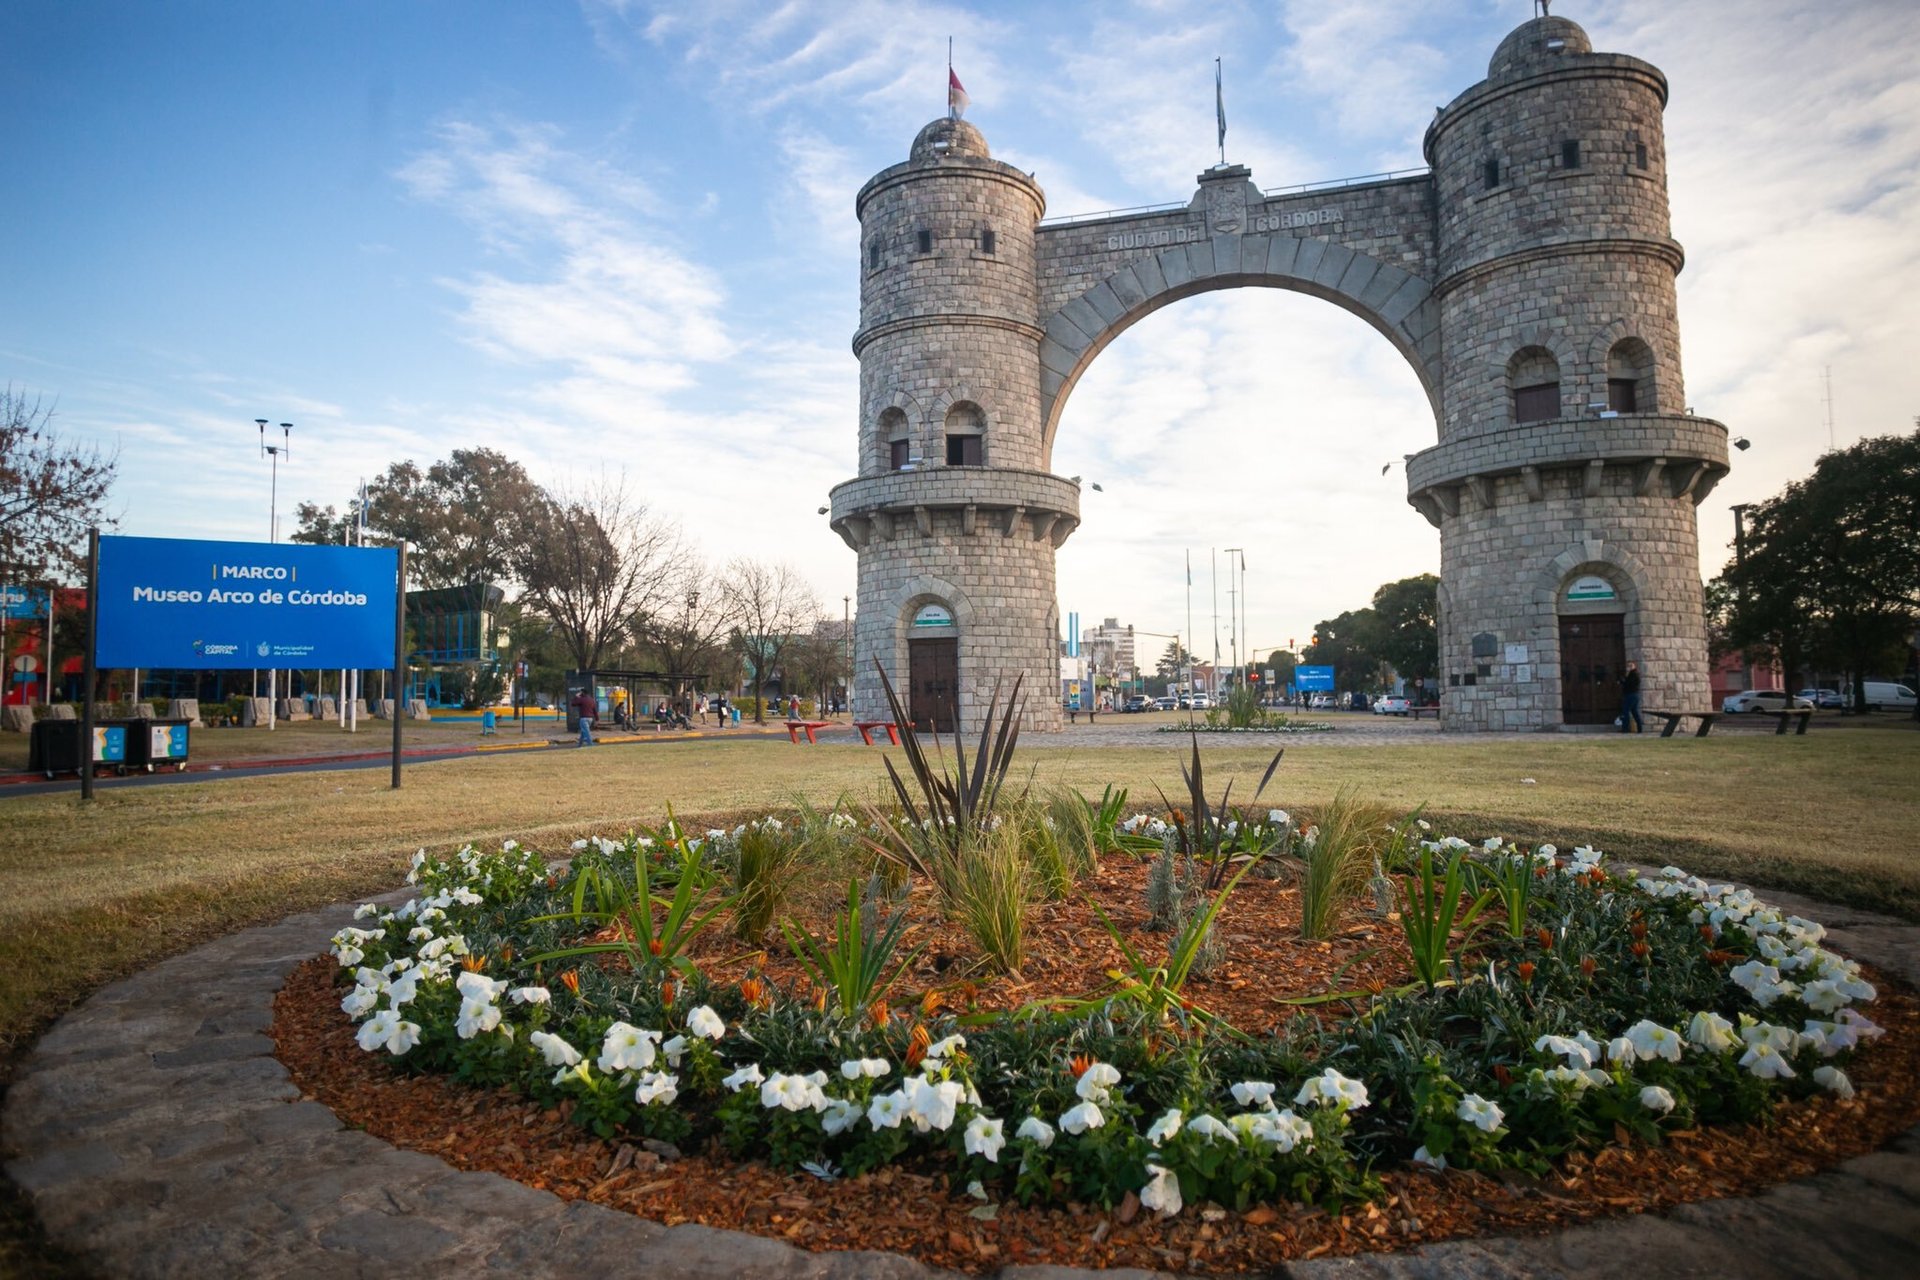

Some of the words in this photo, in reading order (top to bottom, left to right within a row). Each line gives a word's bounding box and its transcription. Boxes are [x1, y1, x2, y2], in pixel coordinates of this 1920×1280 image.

[1107, 229, 1170, 250] CIUDAD
[1176, 227, 1199, 243] DE
[222, 566, 287, 580] MARCO
[133, 586, 203, 603] Museo
[207, 588, 255, 604] Arco
[259, 588, 283, 605] de
[288, 589, 367, 606] Córdoba
